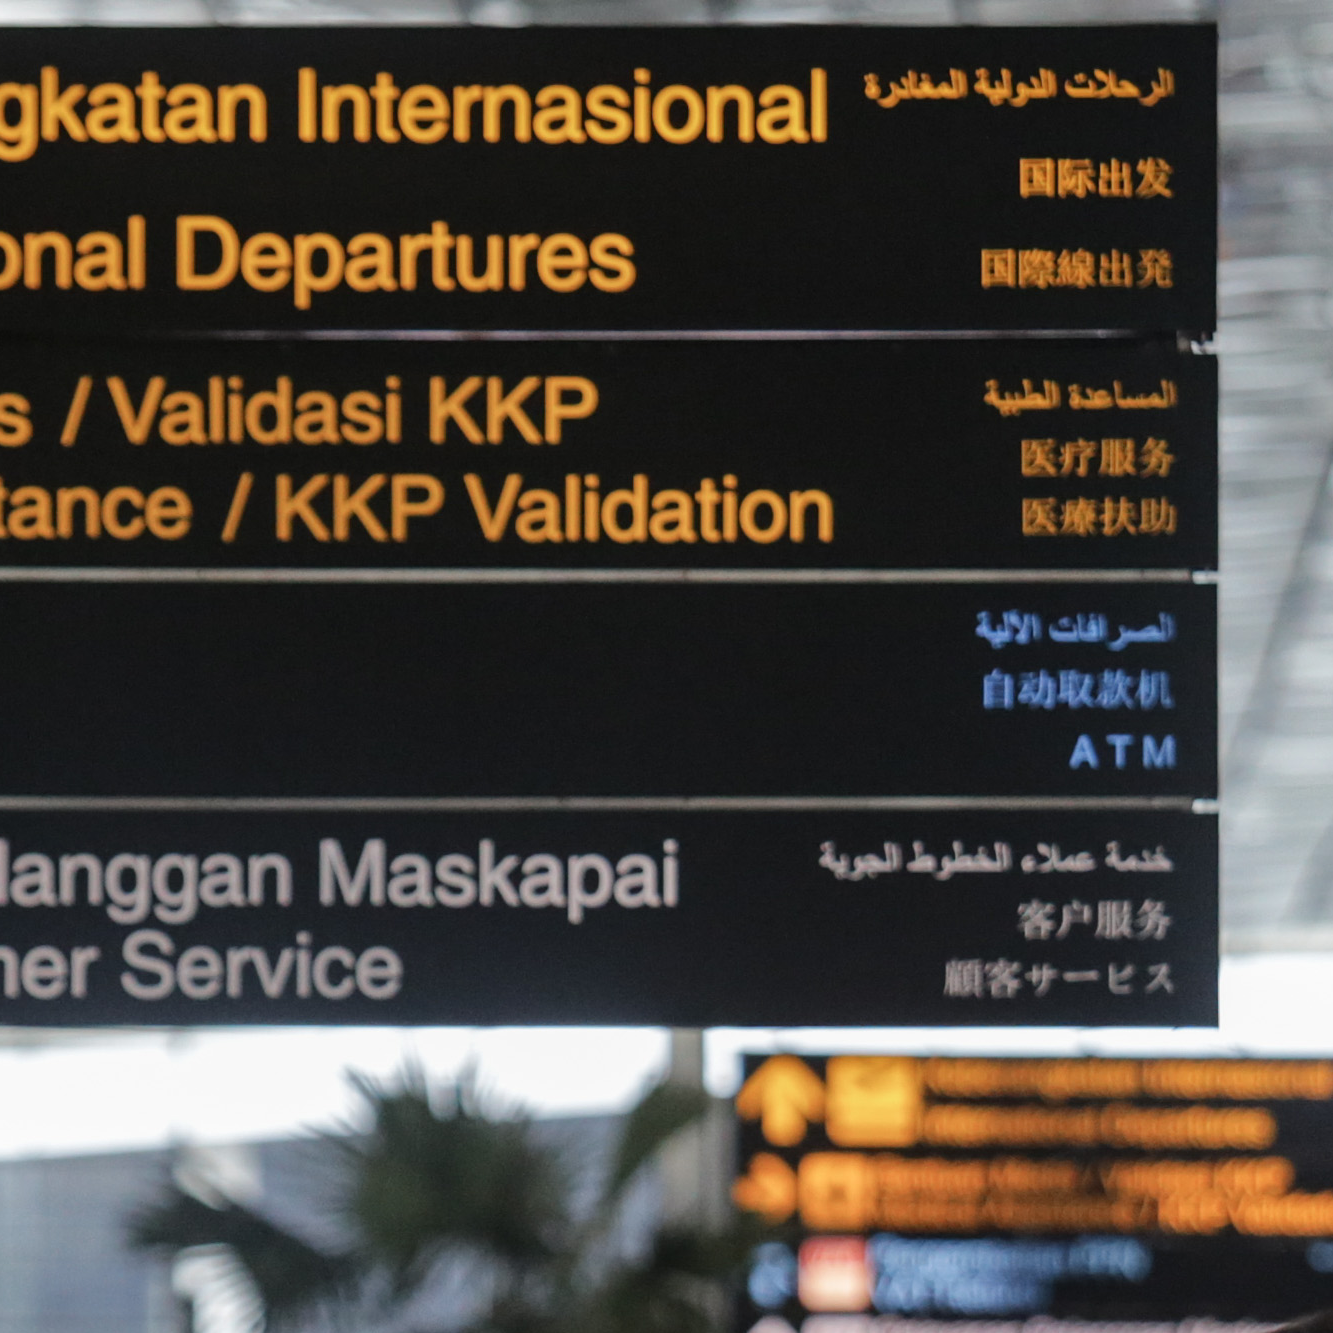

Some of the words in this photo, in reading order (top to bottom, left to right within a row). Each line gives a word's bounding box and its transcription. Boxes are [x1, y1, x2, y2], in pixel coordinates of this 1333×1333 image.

[297, 66, 828, 145] Internasional
[1018, 156, 1173, 199] 国际出发
[175, 214, 637, 310] Departures
[107, 375, 402, 446] Validasi
[429, 375, 599, 445] KKP
[1020, 436, 1175, 478] 医疗服务
[276, 473, 445, 542] KKP
[463, 473, 834, 544] Validation
[981, 667, 1176, 711] 自动取款机
[1067, 732, 1178, 770] ATM
[319, 838, 679, 924] Maskapai
[1016, 898, 1172, 941] 客户服务
[120, 928, 404, 1001] Service
